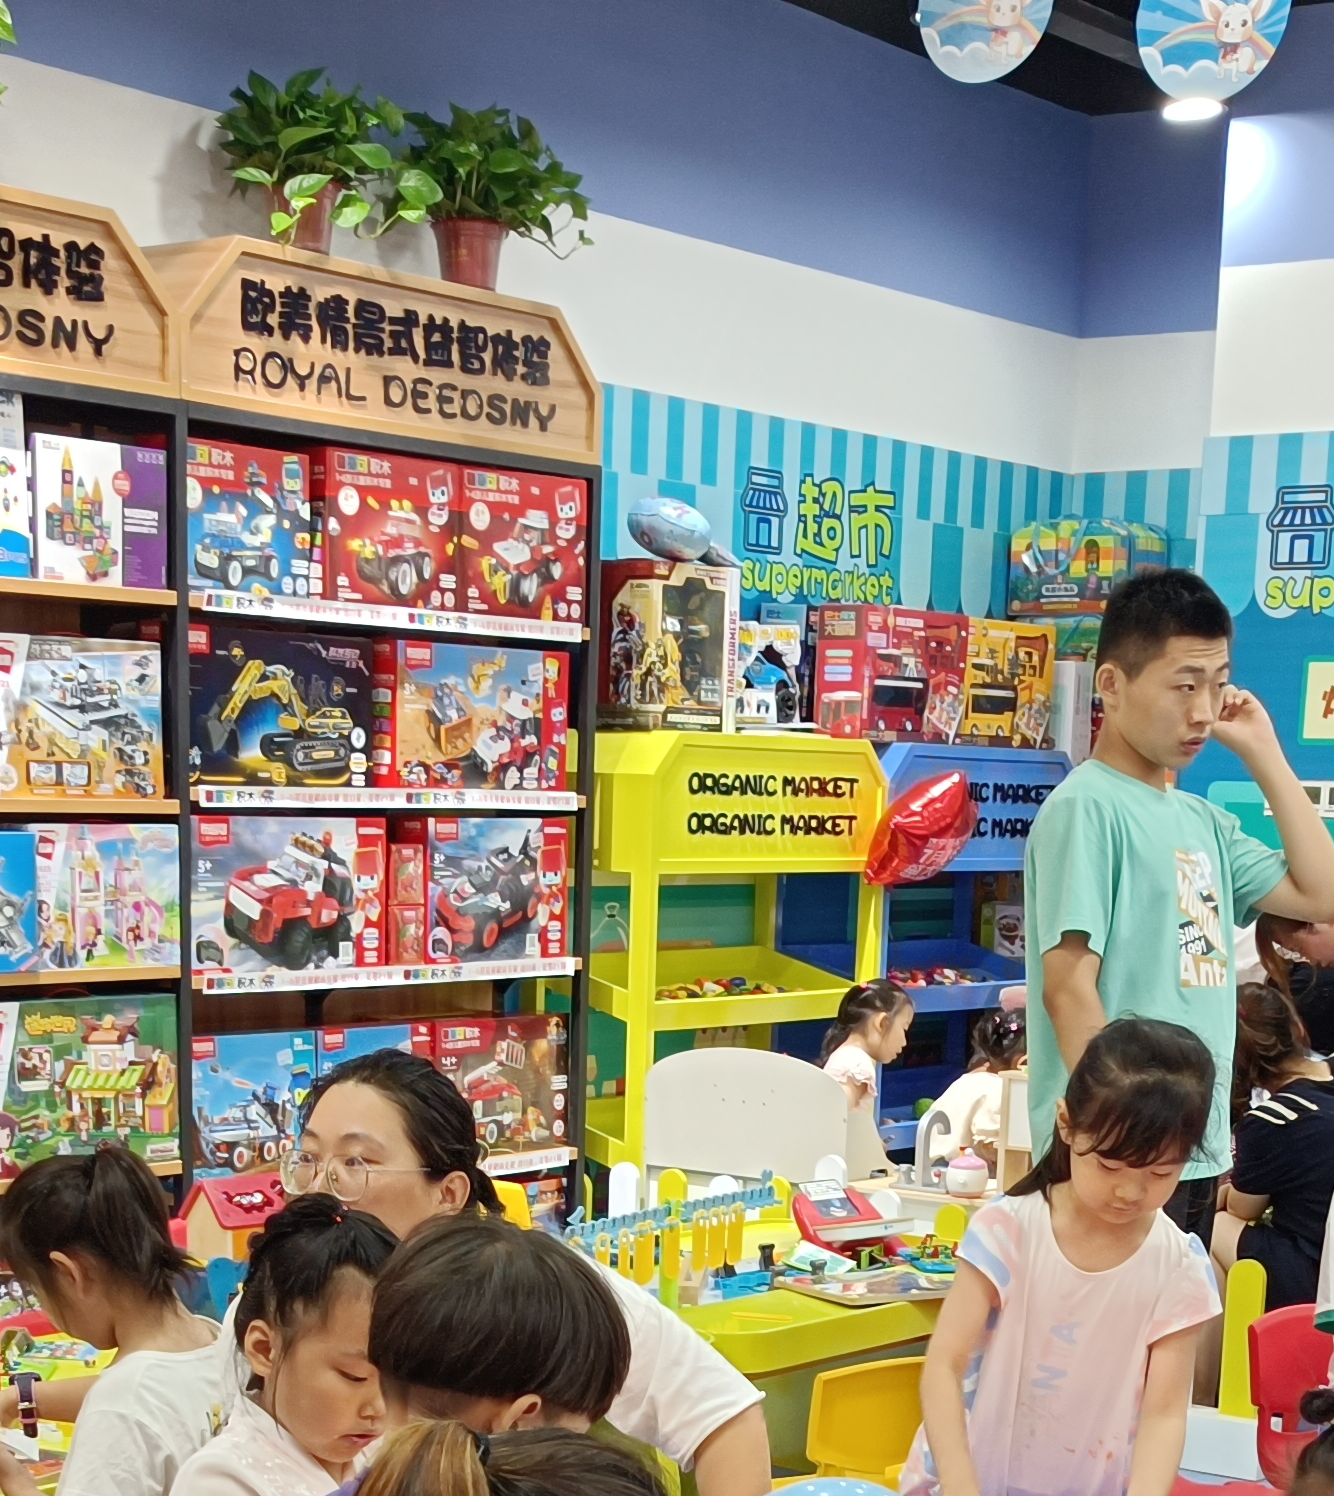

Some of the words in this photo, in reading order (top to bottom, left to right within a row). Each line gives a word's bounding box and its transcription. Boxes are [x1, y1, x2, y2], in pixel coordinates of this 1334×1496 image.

[241, 278, 551, 386] 欧美情景式益智体验
[234, 348, 366, 401] ROYAL
[383, 375, 556, 432] DEEDSNY
[795, 474, 896, 566] 超市
[741, 558, 894, 607] supermarket
[727, 610, 738, 698] TRANSFORMERS
[687, 812, 776, 837] ORGANIC
[780, 814, 857, 837] MARKET
[688, 772, 777, 797] ORGANIC
[782, 775, 858, 799] MARKET
